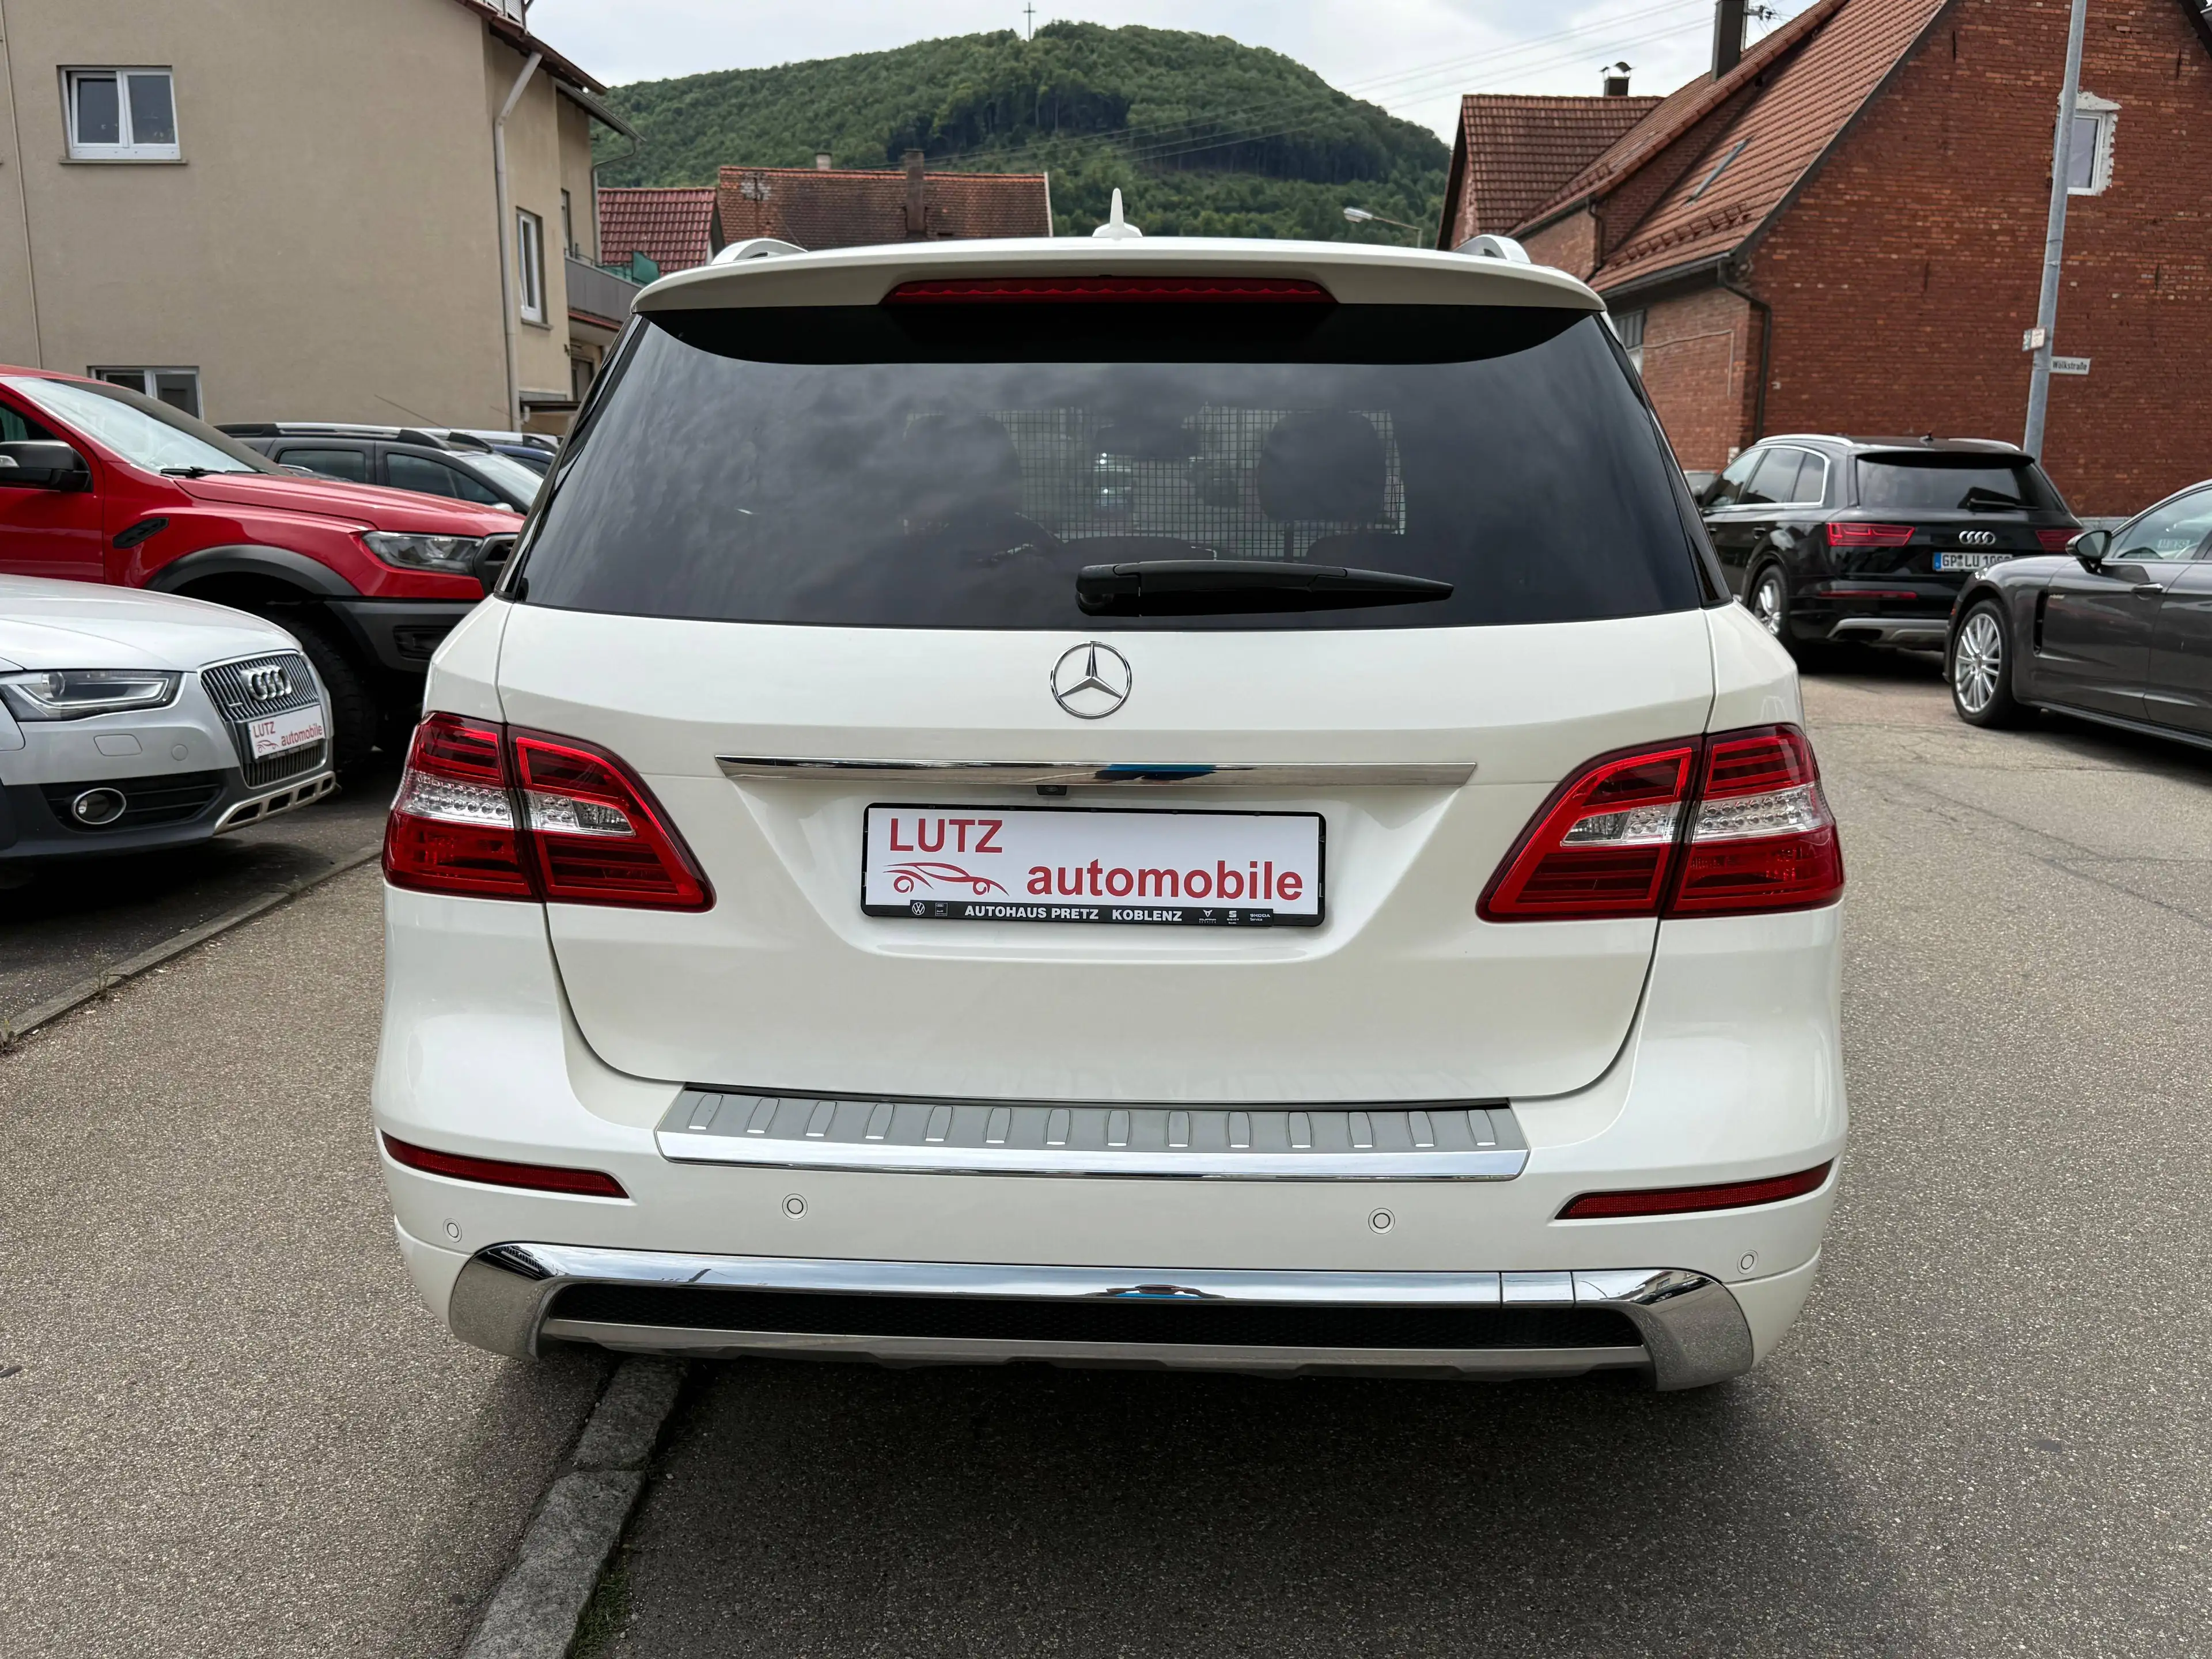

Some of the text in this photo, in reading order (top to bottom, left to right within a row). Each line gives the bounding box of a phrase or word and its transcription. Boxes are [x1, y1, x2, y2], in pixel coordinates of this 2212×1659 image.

[1942, 554, 1957, 567] GP
[1964, 555, 1980, 567] LU
[252, 721, 276, 738] LUTZ
[281, 724, 323, 747] automobile
[889, 819, 1003, 854] LUTZ
[1027, 859, 1303, 901] automobile
[964, 905, 1183, 922] AUTOHAUS PRETZ KOBLENZ
